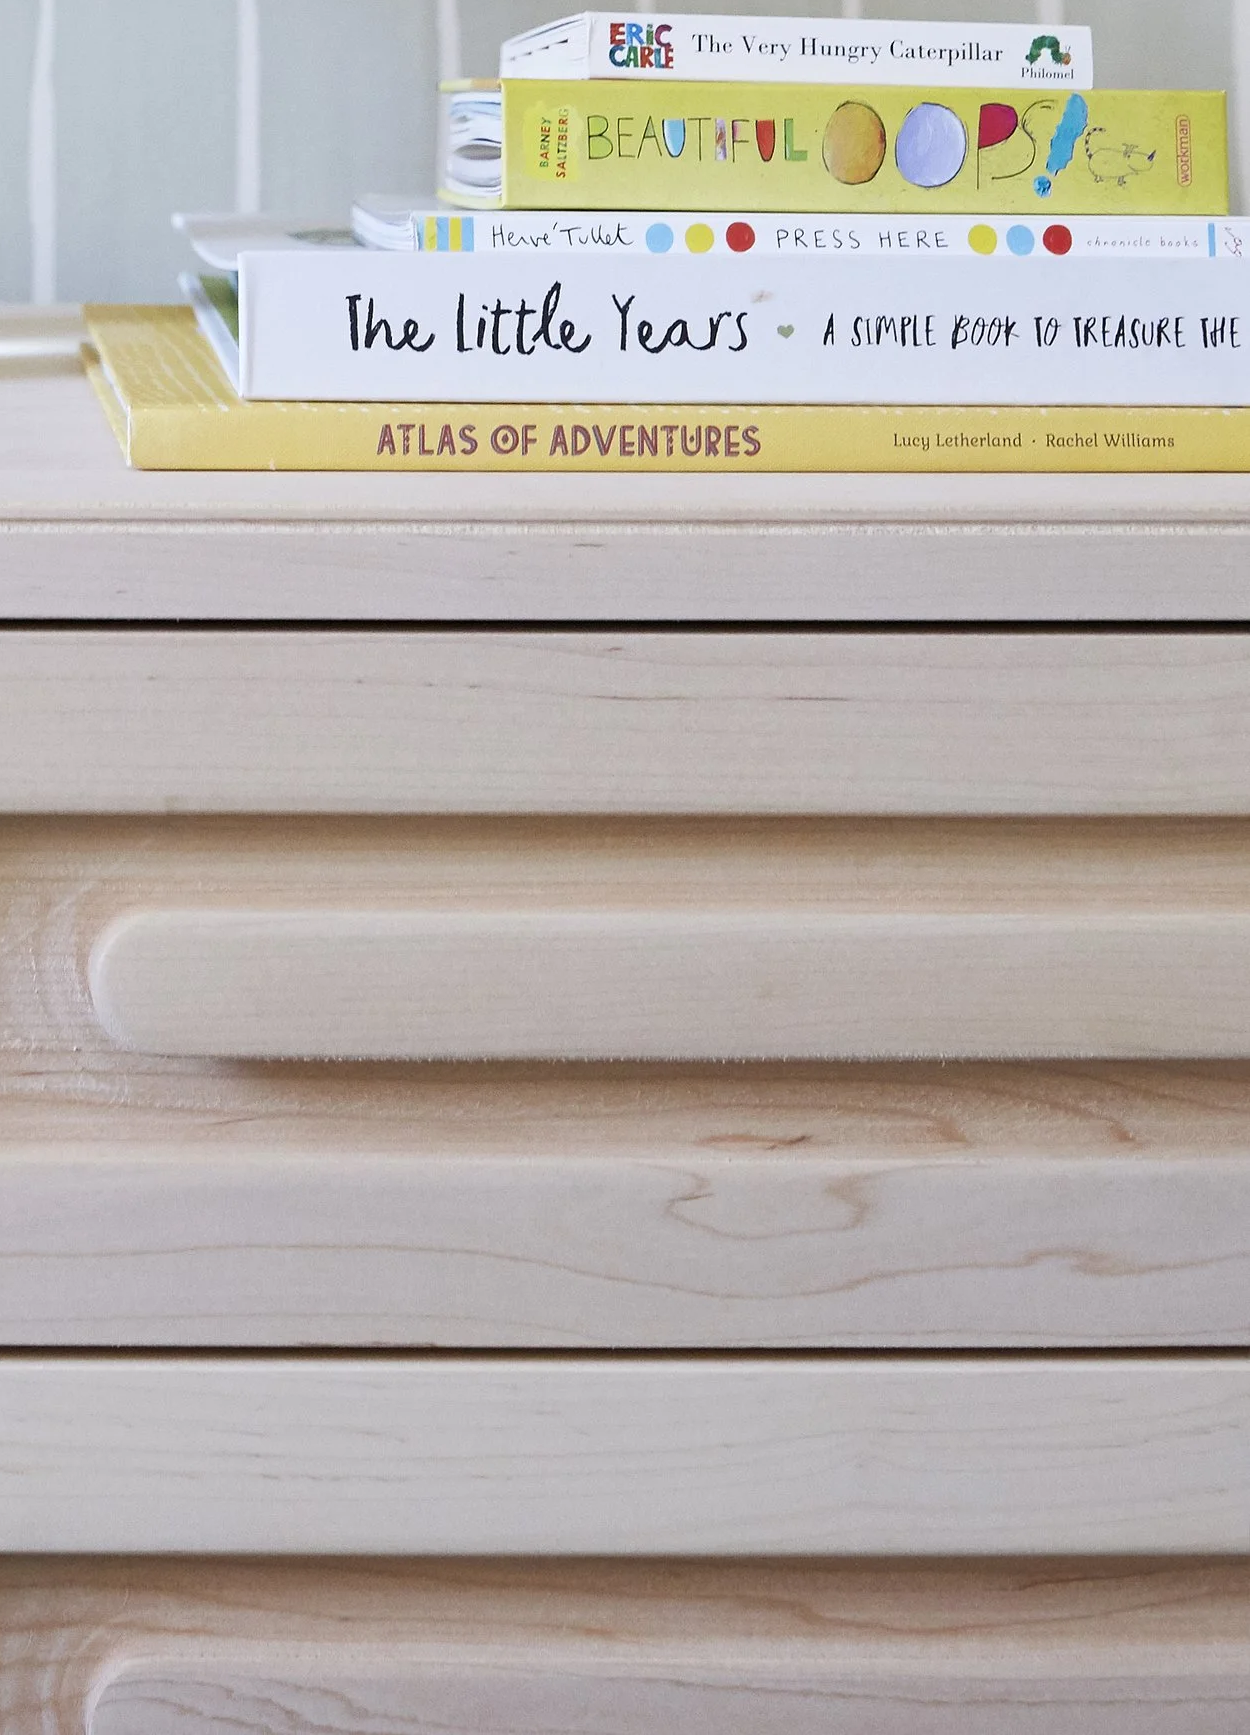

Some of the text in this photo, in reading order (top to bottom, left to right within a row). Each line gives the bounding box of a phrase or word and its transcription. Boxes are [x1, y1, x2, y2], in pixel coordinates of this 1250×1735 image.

[608, 44, 674, 69] CARLE
[692, 33, 1004, 66] The Very Hungry Caterpillar
[1020, 66, 1075, 80] Philomel
[539, 116, 552, 168] BARNEY
[555, 108, 569, 179] SALTZBERG
[586, 114, 809, 162] BEAUTIFUL
[1179, 119, 1192, 184] workman
[559, 222, 635, 247] Tullet
[775, 228, 949, 249] PRESS HERE
[1086, 235, 1199, 248] chronicle books
[345, 280, 749, 355] The Little Years
[822, 312, 1242, 350] A SIMPLE BOOK TO TREASURE THE
[376, 423, 762, 458] ATLAS OF ADVENTURES
[893, 432, 1176, 451] Lucy Letherland Rachel Williams
